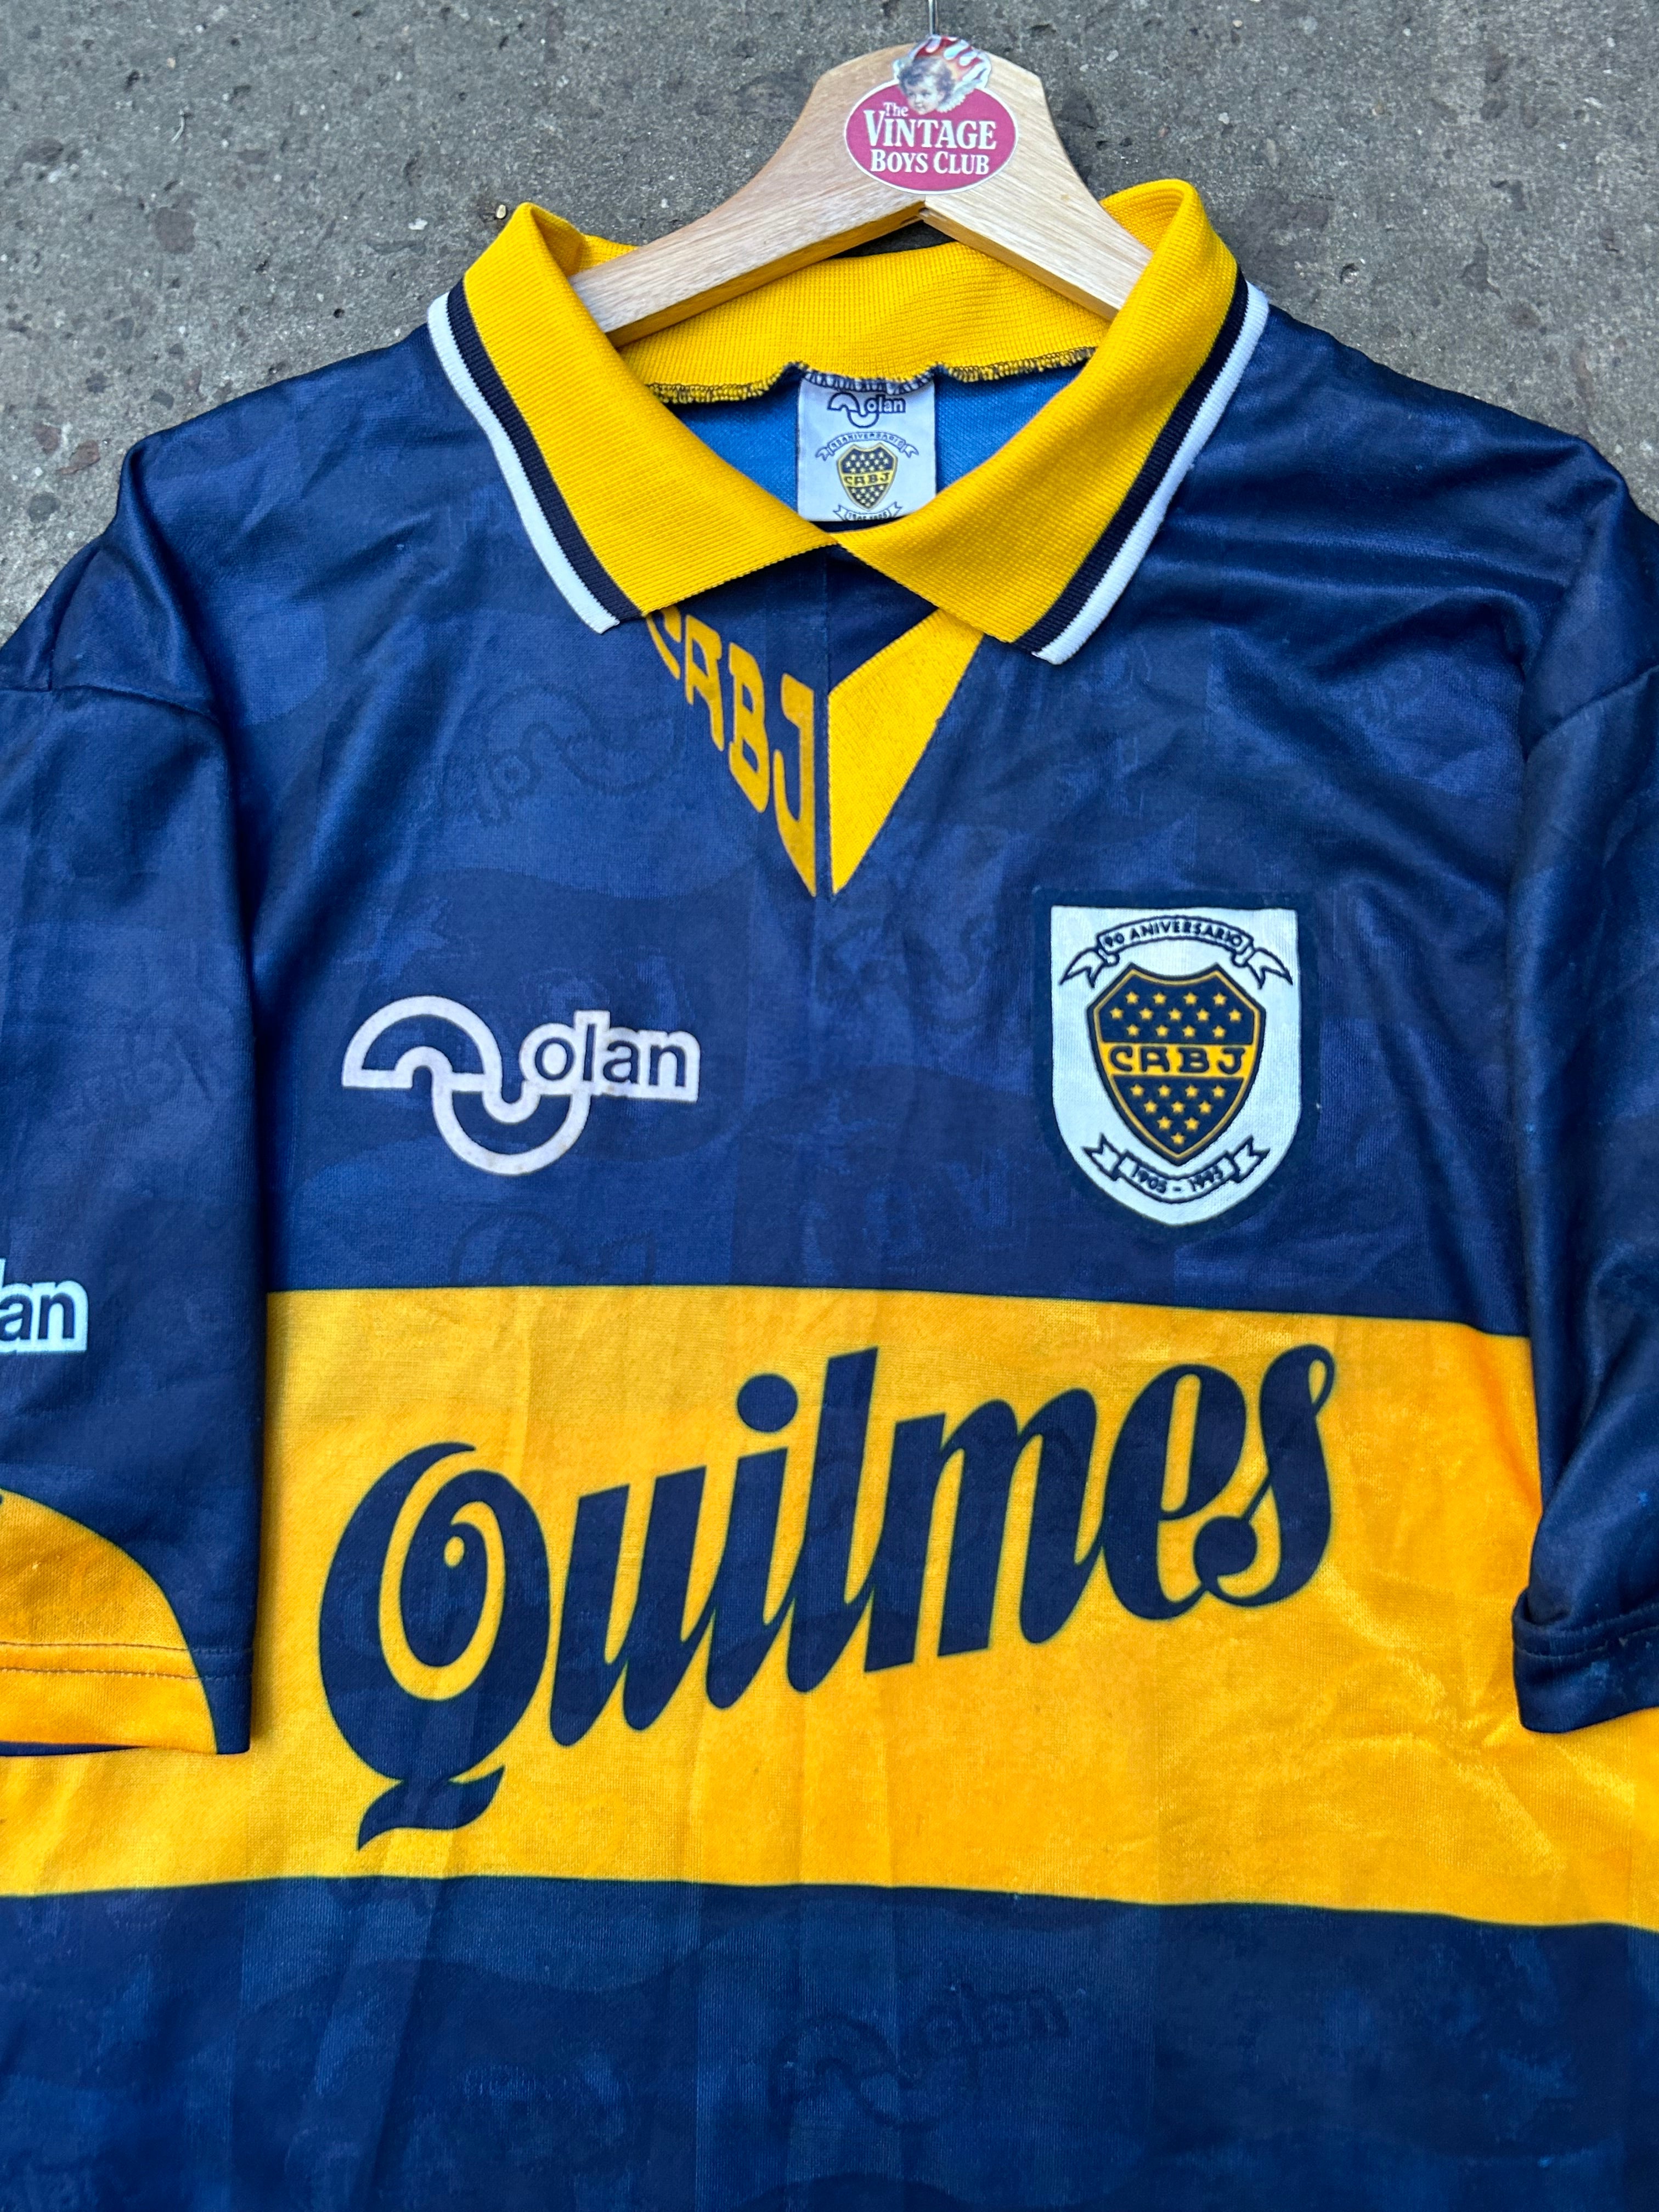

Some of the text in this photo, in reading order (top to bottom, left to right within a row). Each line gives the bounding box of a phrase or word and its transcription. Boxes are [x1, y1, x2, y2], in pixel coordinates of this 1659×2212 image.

[883, 101, 909, 117] The
[863, 110, 997, 150] VINTAGE
[870, 149, 989, 175] BOYS CLUB
[1130, 921, 1243, 947] ANIVERSARIO
[1108, 1046, 1246, 1074] CABJ
[319, 1342, 1335, 1850] Quilmes
